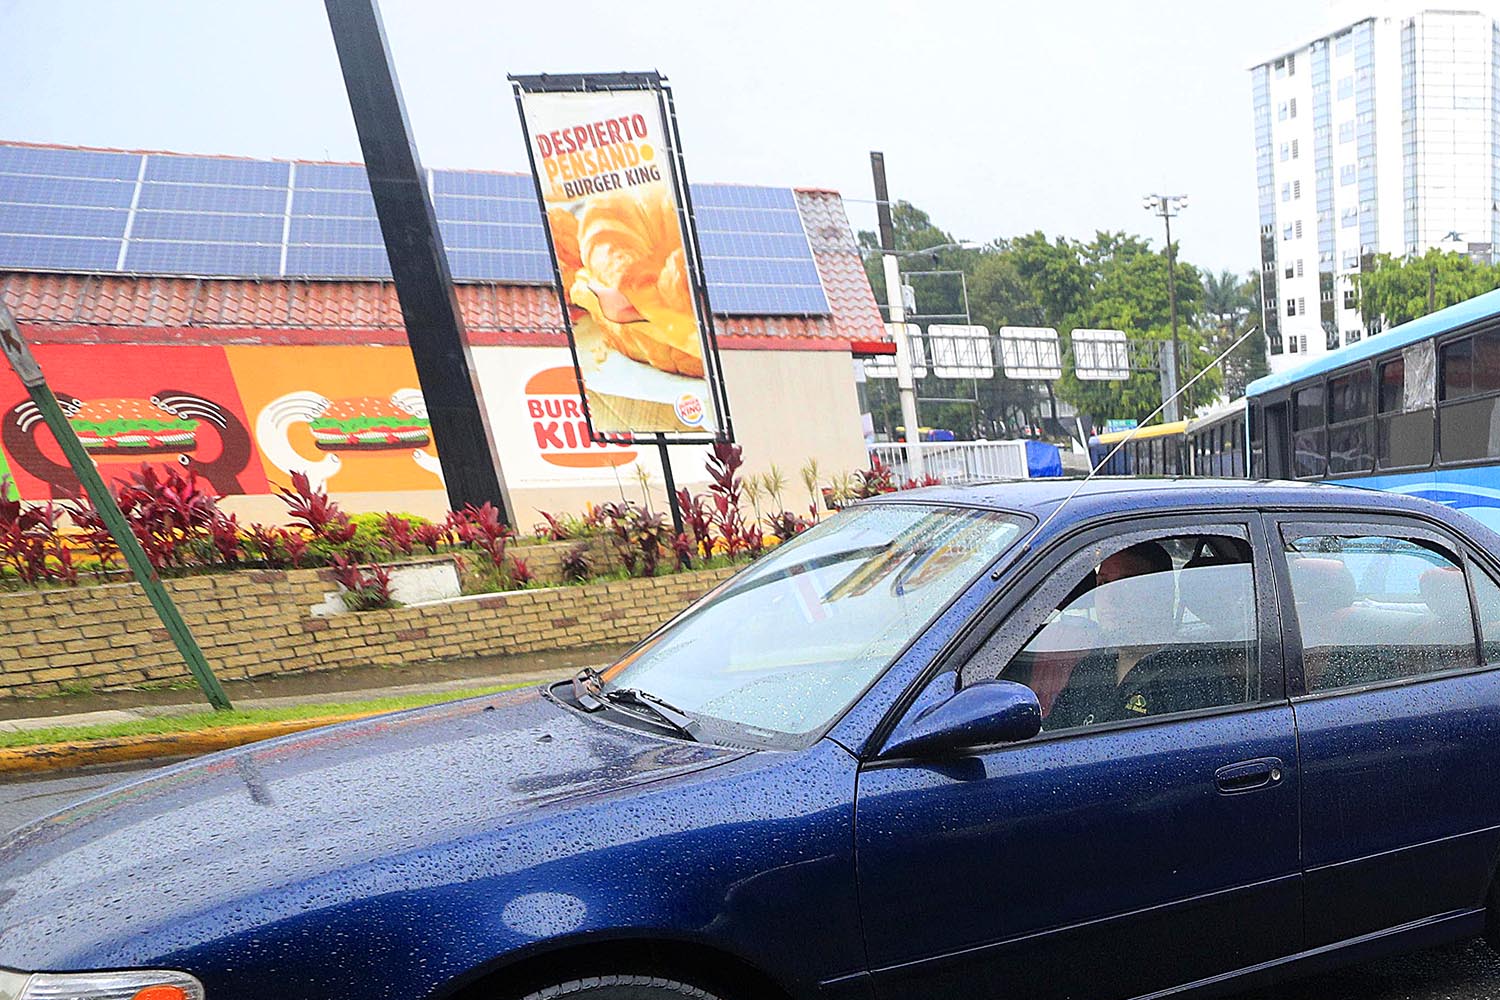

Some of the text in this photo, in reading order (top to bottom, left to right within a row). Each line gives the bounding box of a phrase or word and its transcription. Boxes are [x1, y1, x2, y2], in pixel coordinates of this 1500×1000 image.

[536, 114, 648, 158] DESPIERTO
[563, 173, 621, 199] BURGER
[625, 164, 661, 187] KING
[527, 399, 592, 418] BUR
[533, 421, 633, 449] KIN
